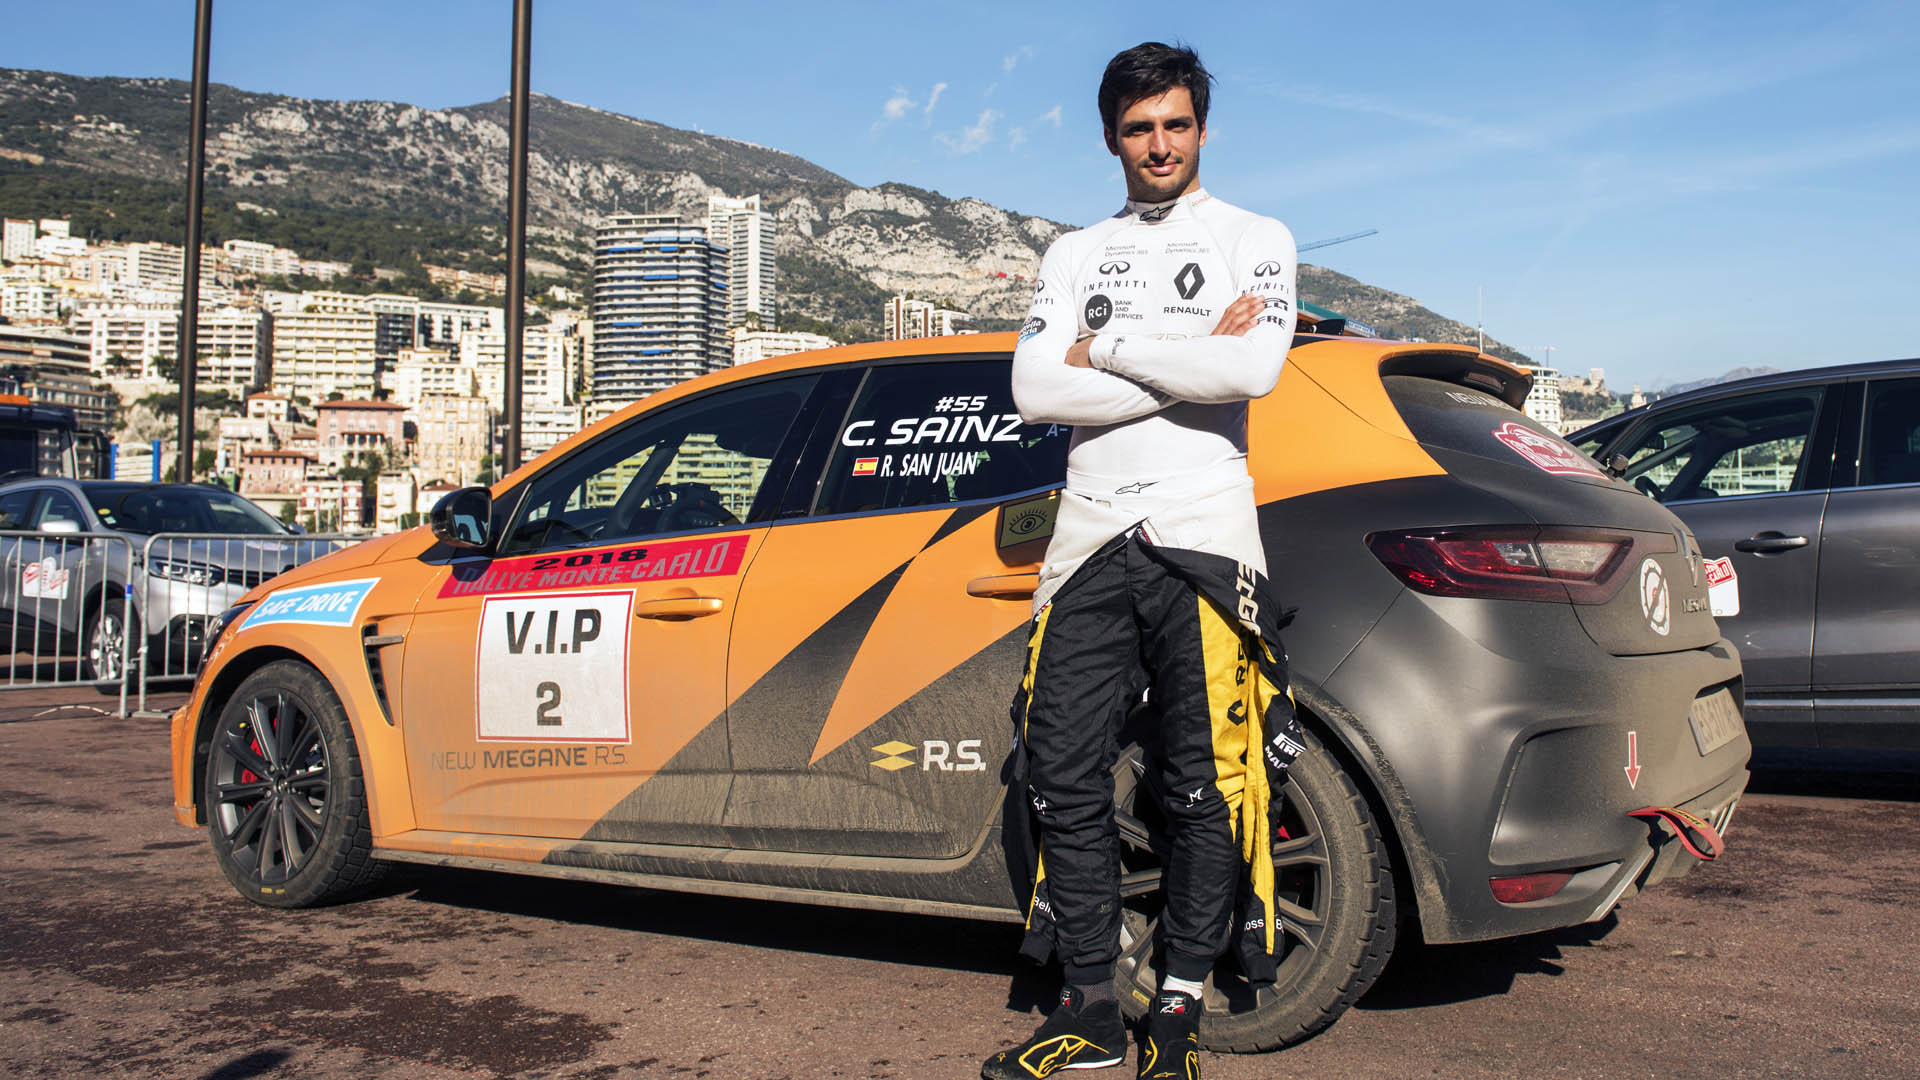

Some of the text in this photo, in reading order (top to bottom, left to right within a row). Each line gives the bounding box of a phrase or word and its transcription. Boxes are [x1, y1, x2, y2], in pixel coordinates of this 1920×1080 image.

[1084, 280, 1147, 294] INFINITI
[1241, 282, 1289, 297] NFINITI
[1088, 302, 1108, 320] RCi
[1163, 306, 1212, 317] RENAULT
[1256, 315, 1287, 330] FRE
[935, 395, 988, 413] #55
[841, 414, 1024, 447] C. SAINZ
[880, 451, 979, 484] R. SAN JUAN
[453, 541, 729, 594] RALLYE MONTE-CARLO
[531, 549, 648, 571] 2018
[253, 590, 360, 619] SAFE DRIVE
[506, 609, 601, 655] V.I.P
[536, 682, 562, 726] 2
[431, 751, 476, 771] NEW
[483, 747, 587, 769] MEGANE
[922, 740, 987, 771] R.S.
[1264, 745, 1289, 769] MAP
[1244, 919, 1265, 932] oss
